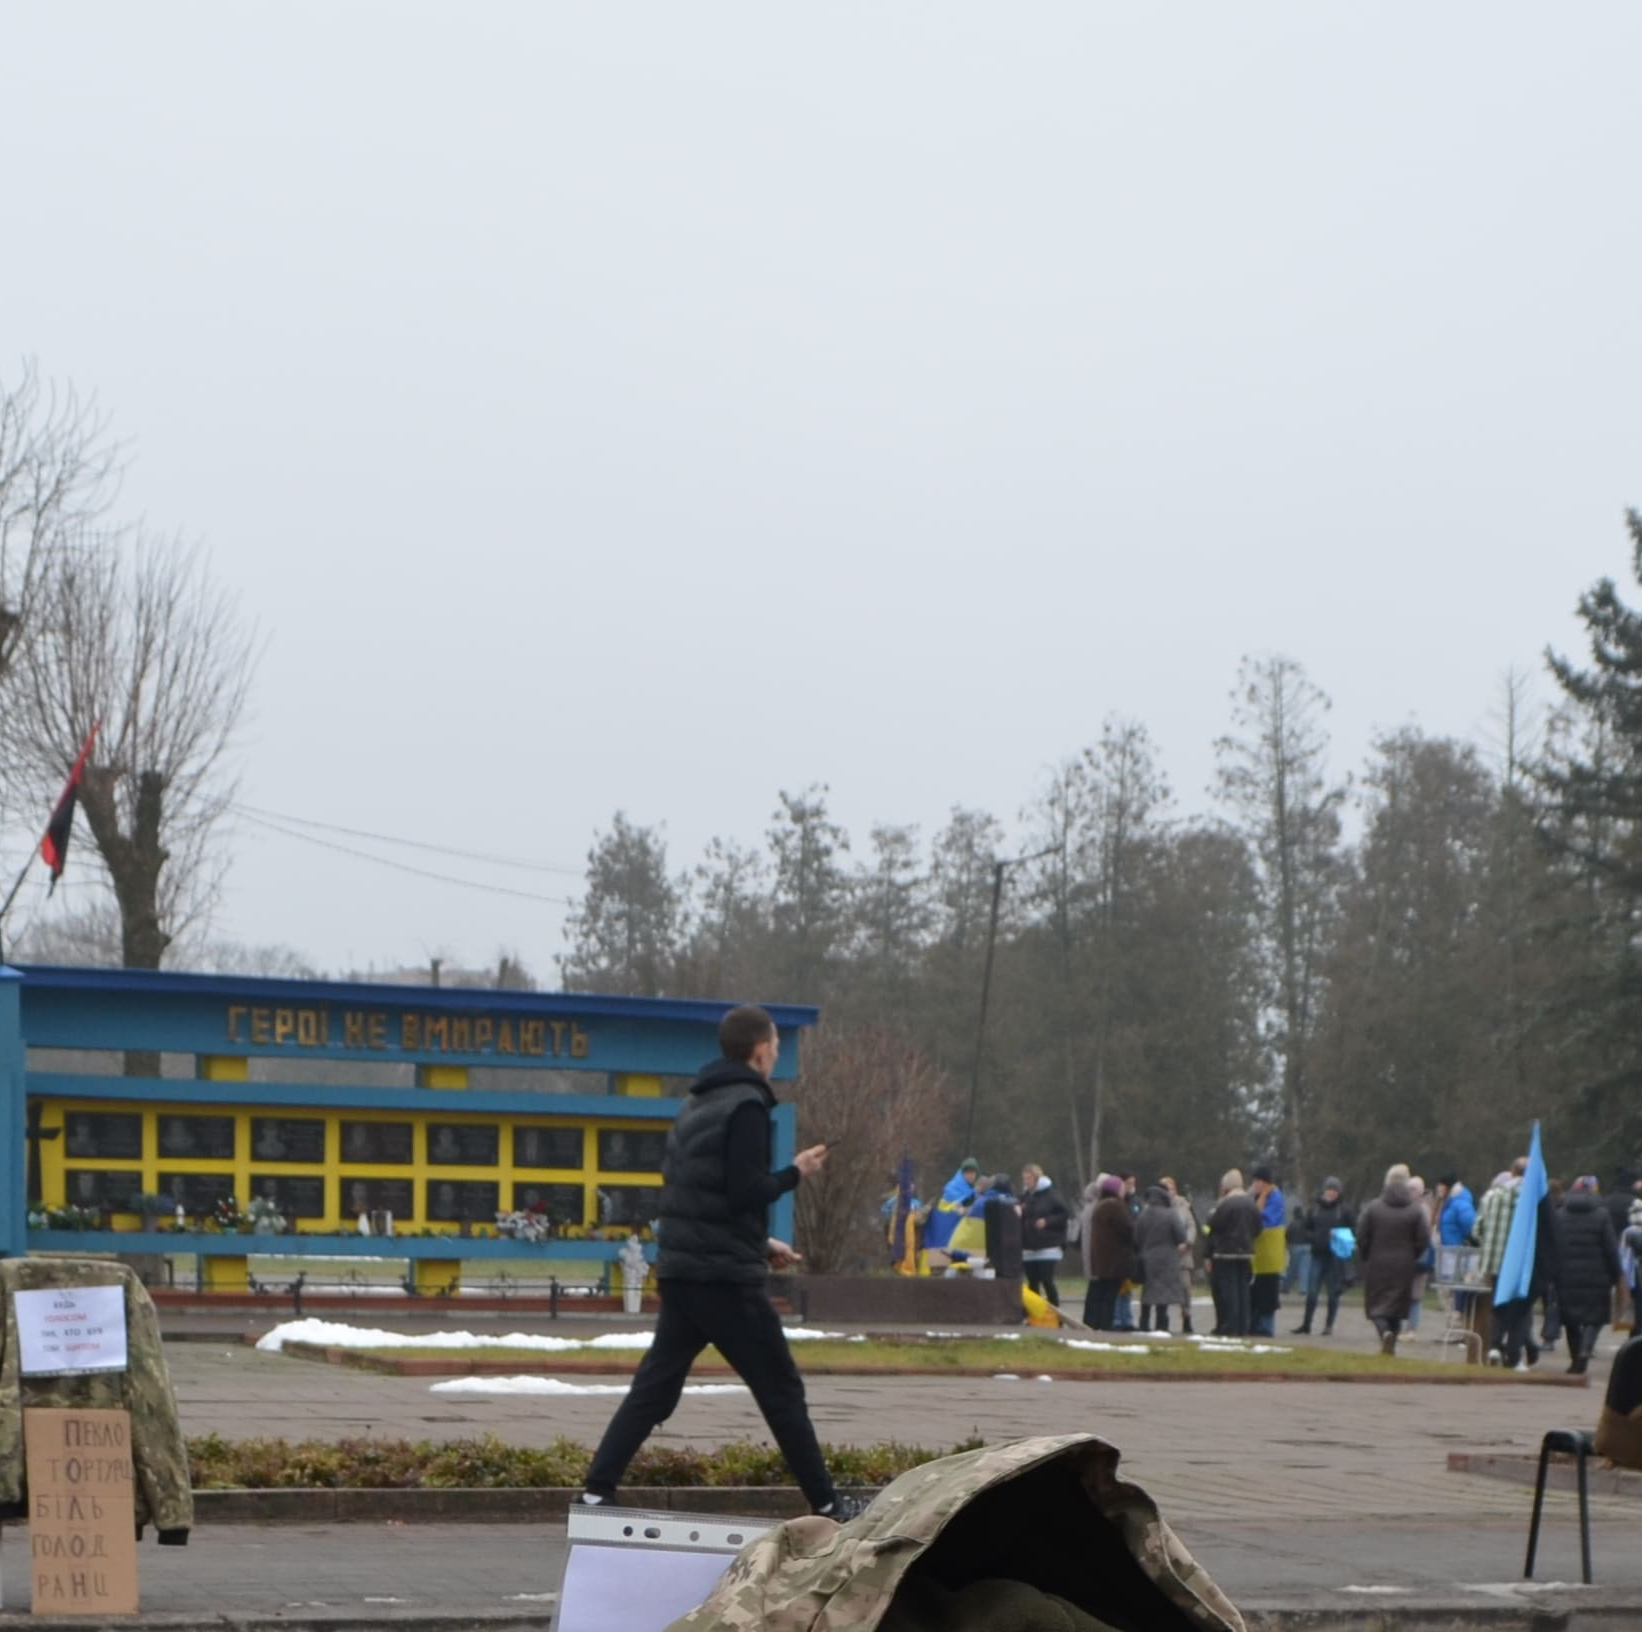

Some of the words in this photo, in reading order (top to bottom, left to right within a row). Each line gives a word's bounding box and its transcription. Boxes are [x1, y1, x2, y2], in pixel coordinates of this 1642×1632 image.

[227, 1001, 329, 1046] ГЕРОЇ
[344, 1010, 387, 1050] НЕ
[401, 1014, 590, 1059] ВМИРАЮТЬ
[65, 1419, 125, 1449] ПЕКЛО
[36, 1493, 104, 1521] БІЛЬ
[32, 1533, 110, 1559] ГОЛОД
